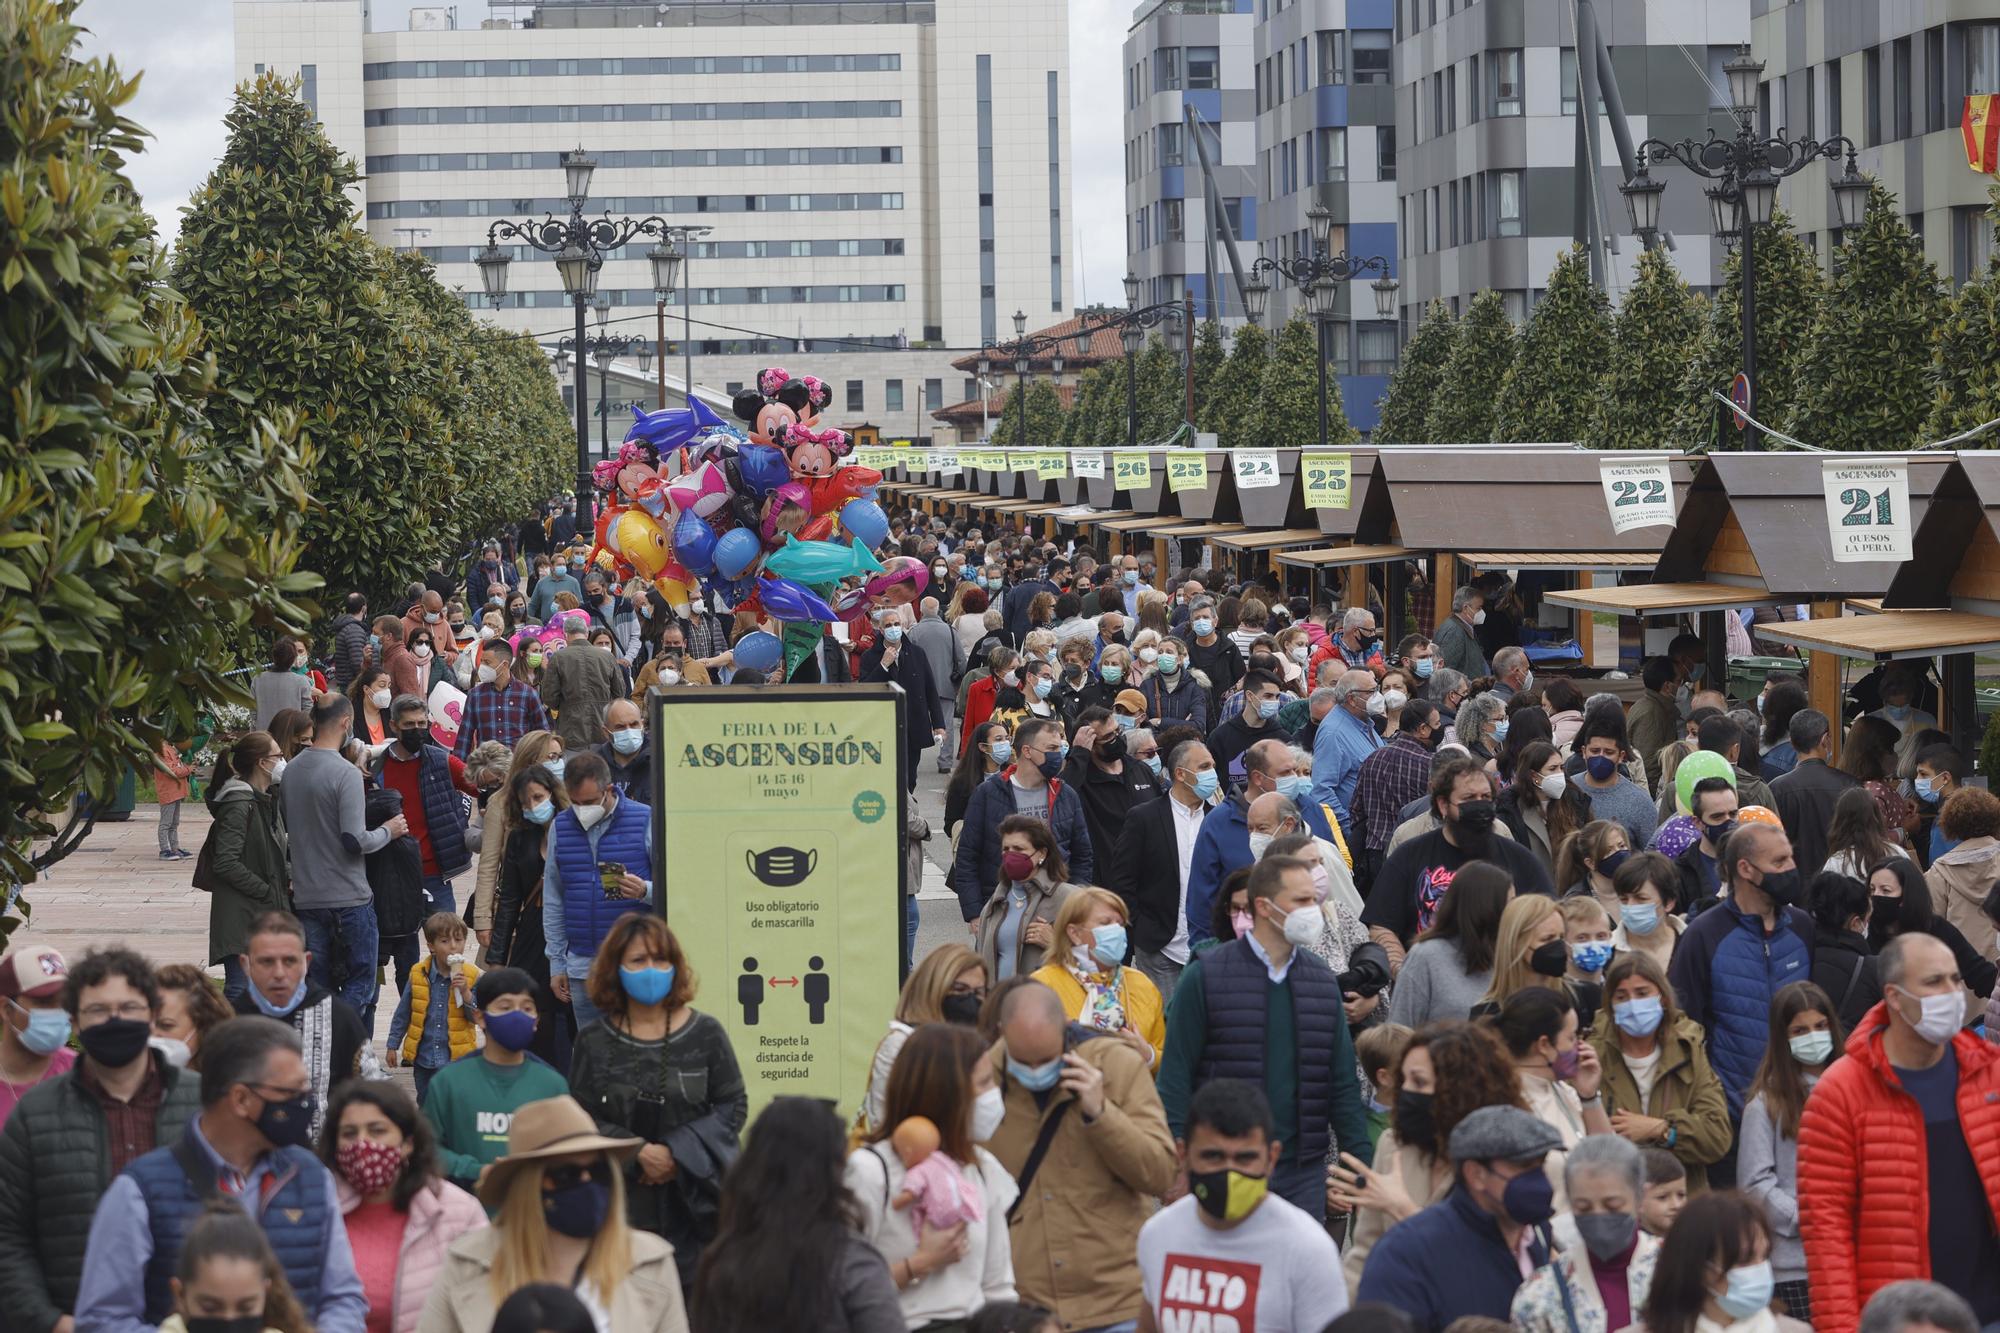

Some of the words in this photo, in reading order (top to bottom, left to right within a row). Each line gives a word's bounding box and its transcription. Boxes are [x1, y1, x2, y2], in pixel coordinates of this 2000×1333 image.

[1040, 459, 1064, 470] 28
[1076, 459, 1101, 469] 27
[1117, 461, 1147, 477] 26
[1171, 463, 1203, 478] 25
[1239, 461, 1273, 476] 24
[1834, 468, 1897, 480] ASCENSIÓN
[1612, 479, 1667, 507] 22
[1840, 487, 1895, 527] 21
[1848, 534, 1890, 543] QUESOS
[1845, 544, 1859, 553] LA
[1862, 544, 1896, 552] PERAL
[722, 722, 777, 737] FERIA
[783, 722, 809, 736] DE
[813, 721, 838, 736] LA
[678, 735, 884, 768] ASCENSIÓN
[763, 788, 800, 800] mayo
[858, 799, 881, 808] Oviedo
[861, 808, 878, 817] 2021
[745, 901, 766, 912] Uso
[766, 901, 820, 914] obligatorio
[751, 918, 764, 928] de
[765, 916, 815, 928] mascarilla
[759, 1036, 799, 1050] Respete
[800, 1035, 810, 1046] la
[755, 1051, 801, 1064] distancia
[801, 1052, 814, 1063] de
[760, 1068, 809, 1081] seguridad
[1164, 1265, 1247, 1311] ALTO
